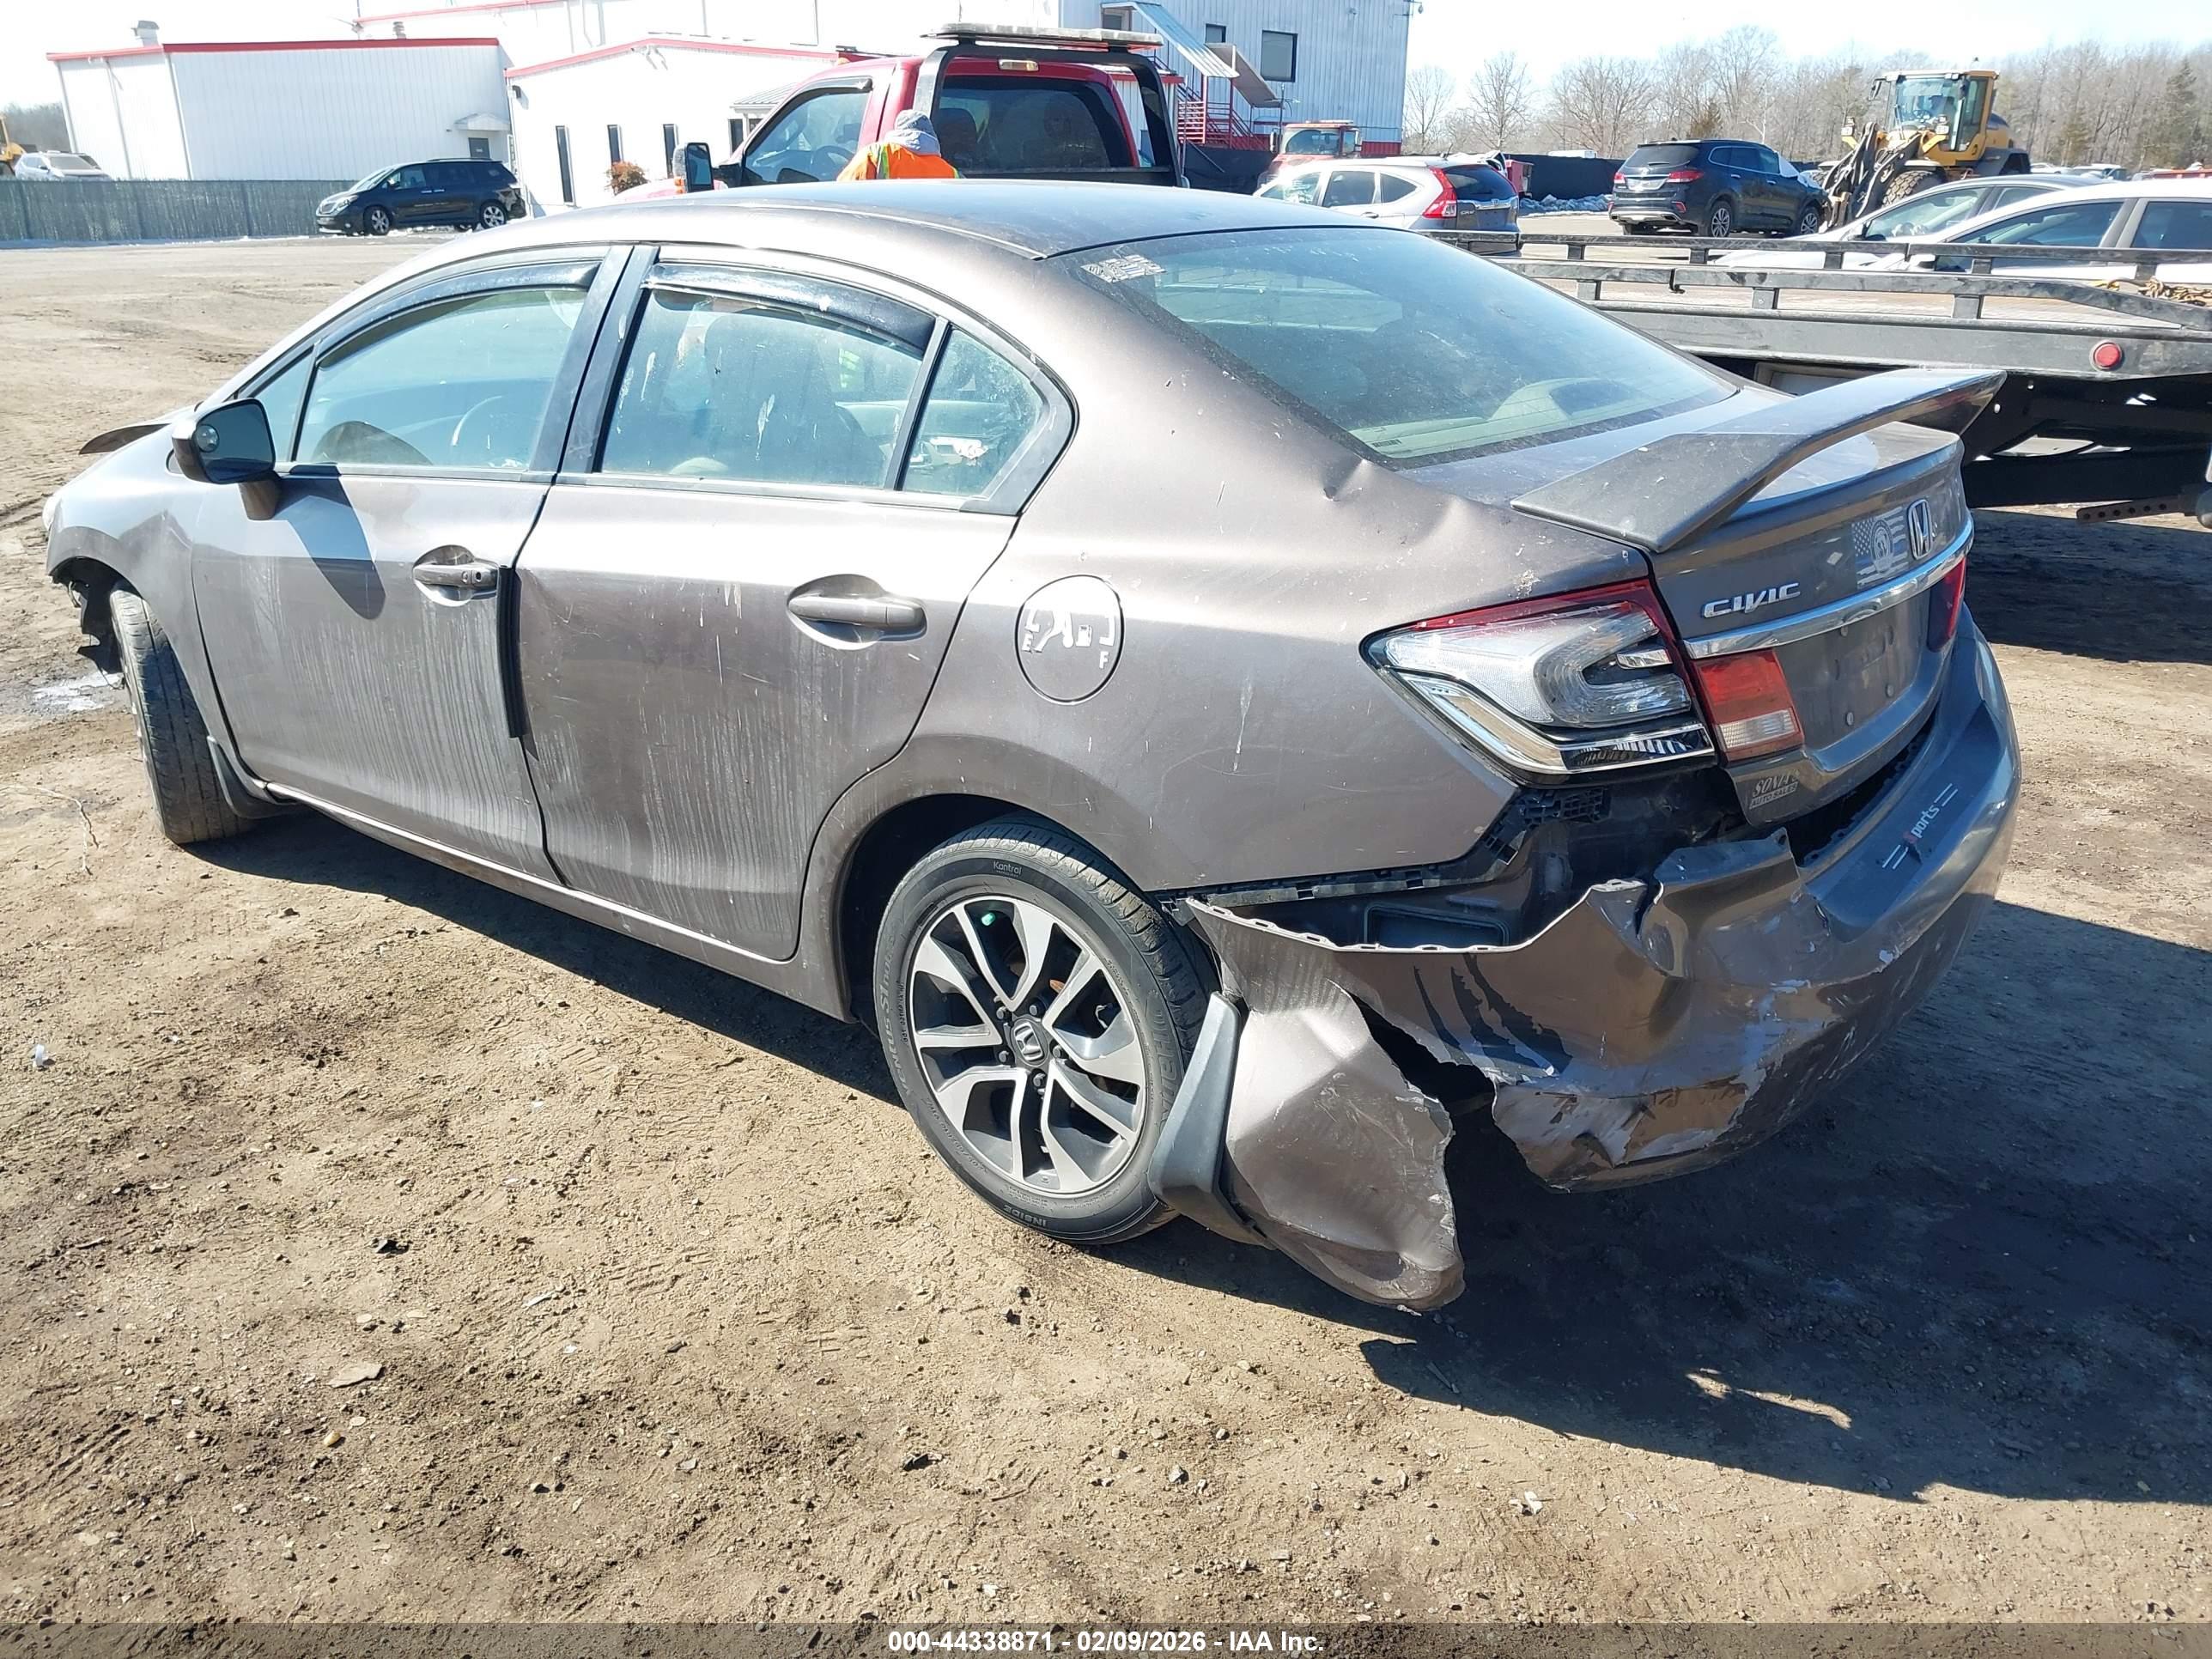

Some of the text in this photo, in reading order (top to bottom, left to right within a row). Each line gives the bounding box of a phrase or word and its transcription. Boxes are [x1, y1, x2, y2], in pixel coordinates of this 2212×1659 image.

[1704, 582, 1801, 618] CIVIC
[1022, 633, 1034, 653] E
[1098, 651, 1109, 669] F
[993, 860, 1022, 875] Kontrol
[1003, 1204, 1048, 1227] INSIDE
